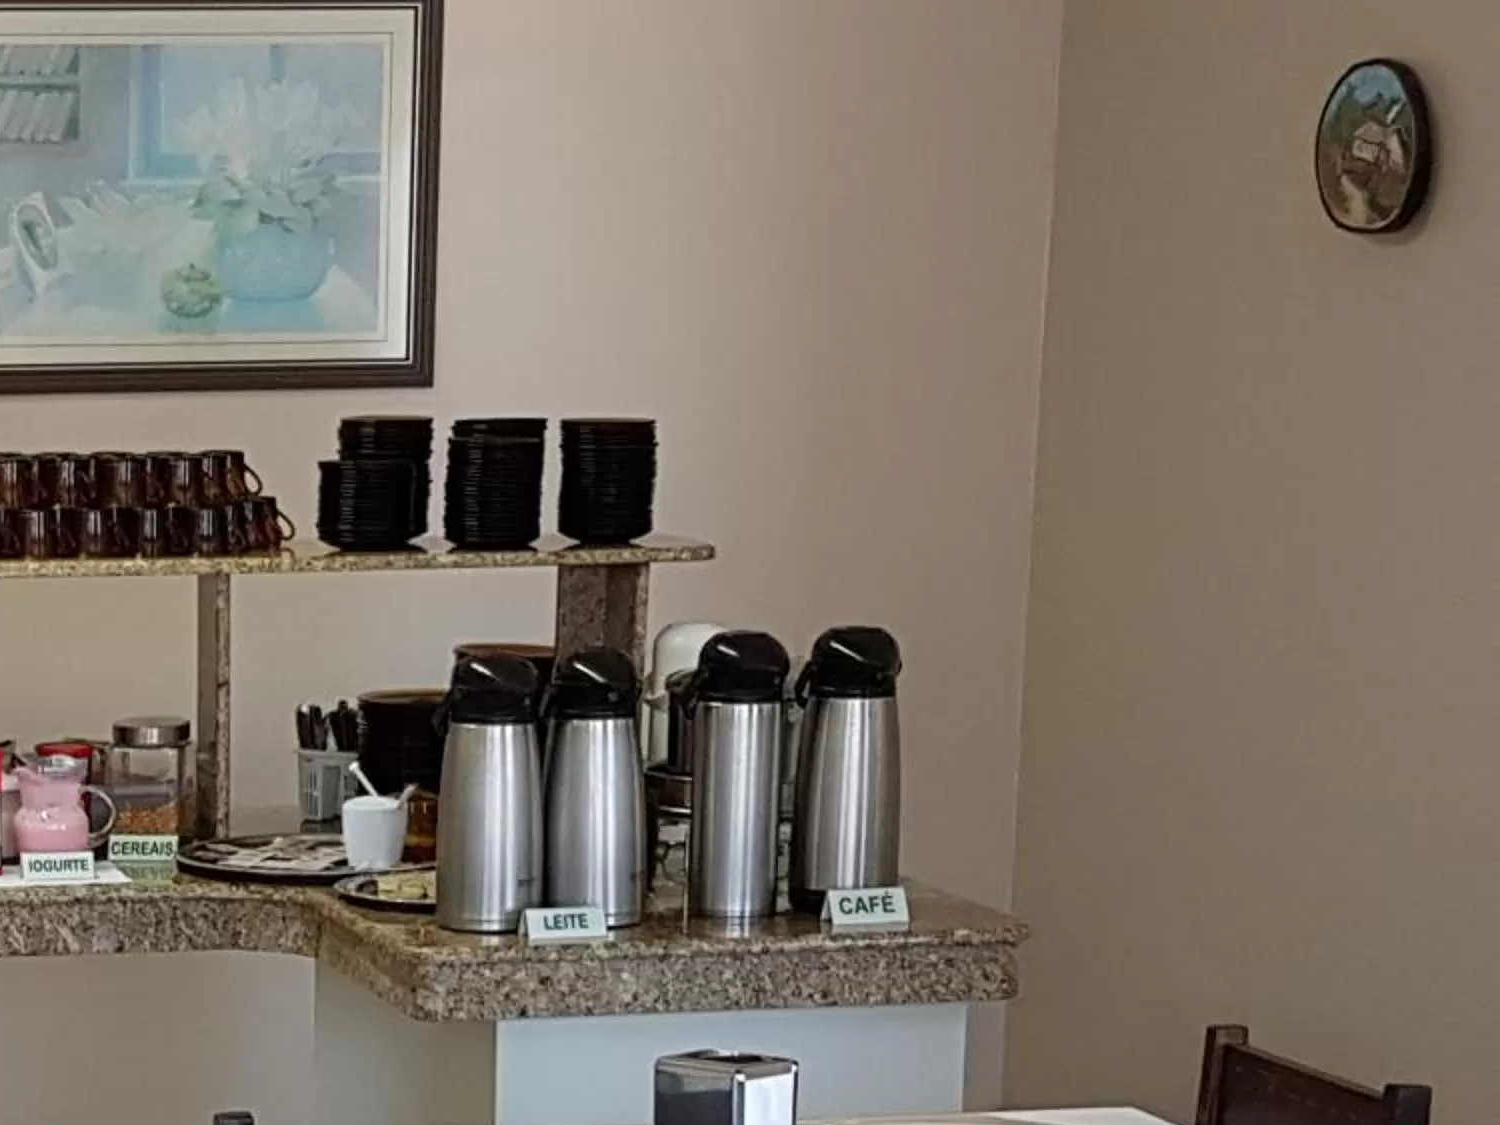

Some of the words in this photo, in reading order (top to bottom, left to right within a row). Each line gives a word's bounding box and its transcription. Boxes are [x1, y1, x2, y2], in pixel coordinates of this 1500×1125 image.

[111, 841, 173, 856] CEREAIS
[28, 858, 90, 873] IOGURTE
[838, 888, 896, 915] CAFÉ
[543, 912, 589, 930] LEITE
